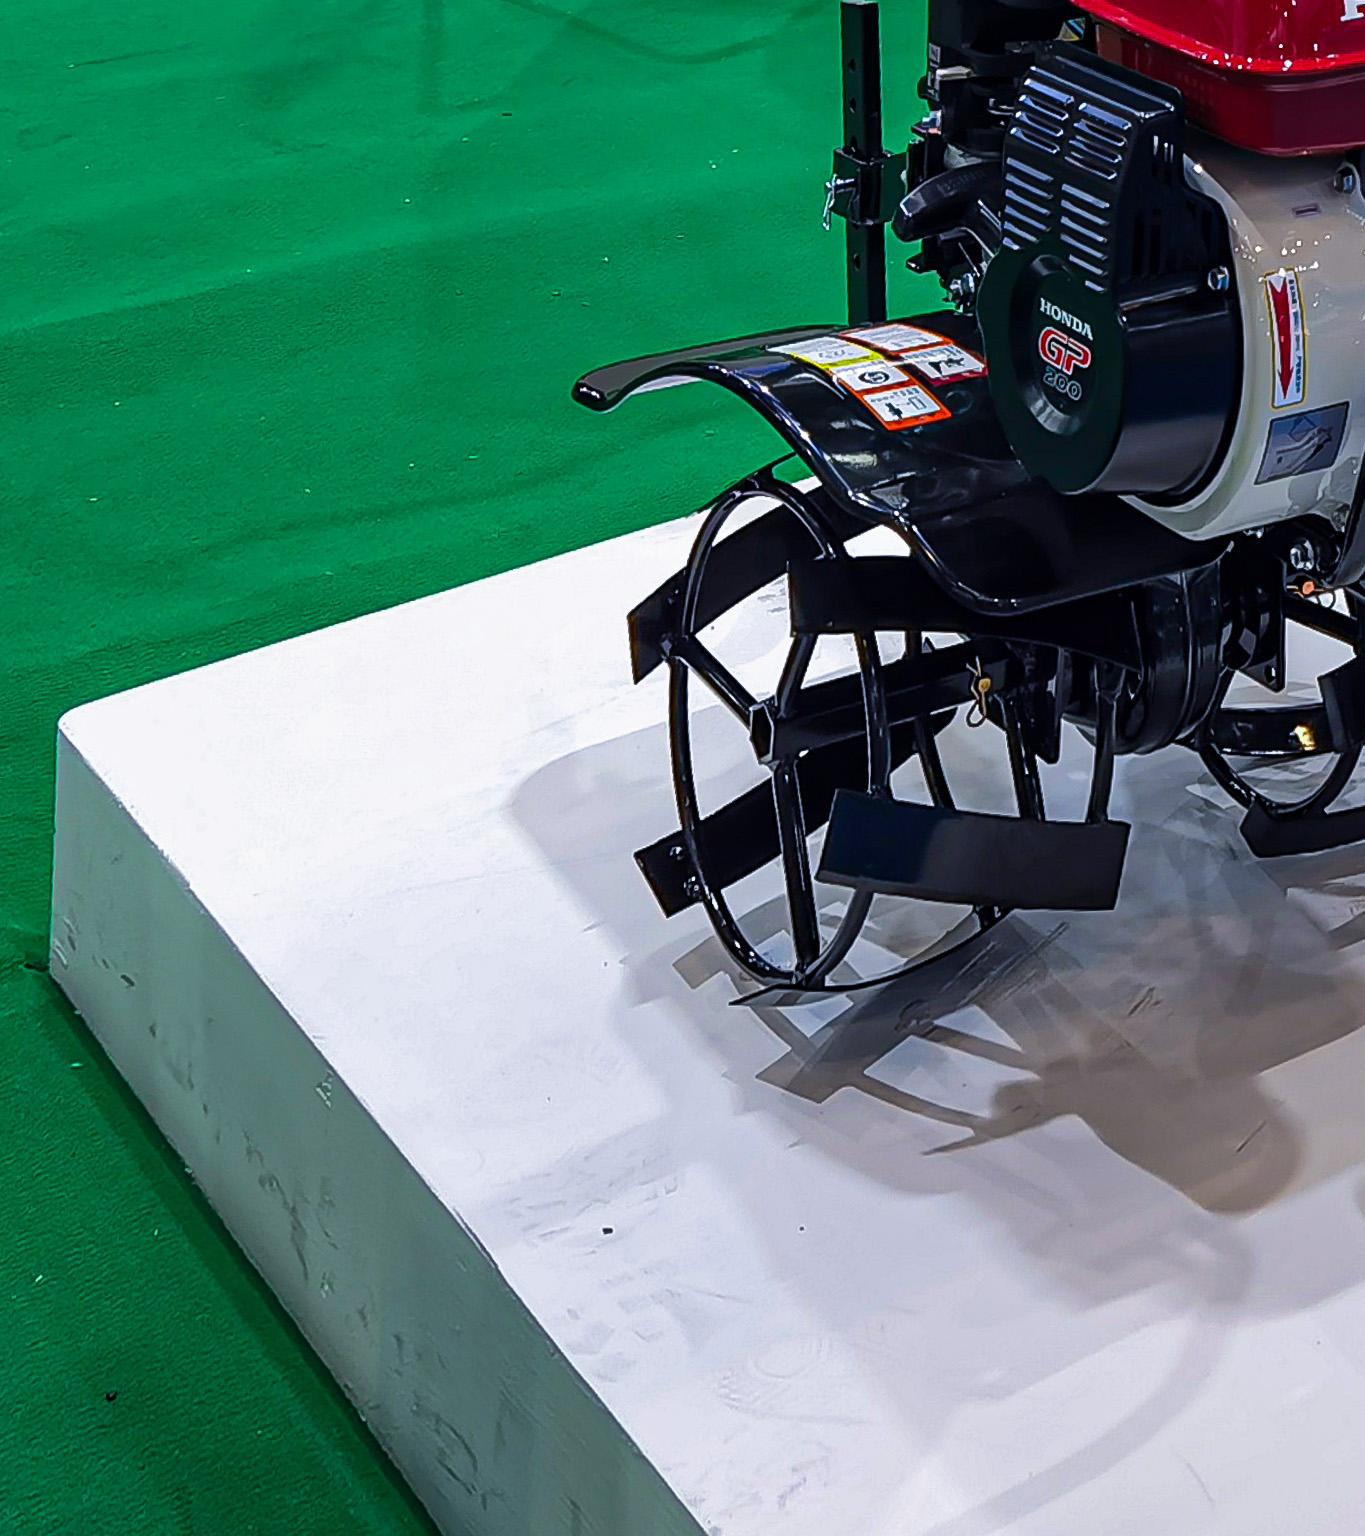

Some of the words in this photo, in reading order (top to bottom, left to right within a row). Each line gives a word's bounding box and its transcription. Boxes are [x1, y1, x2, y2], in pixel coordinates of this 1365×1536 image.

[1039, 297, 1094, 341] HONDA
[1038, 326, 1092, 375] GP
[1042, 365, 1082, 401] 200
